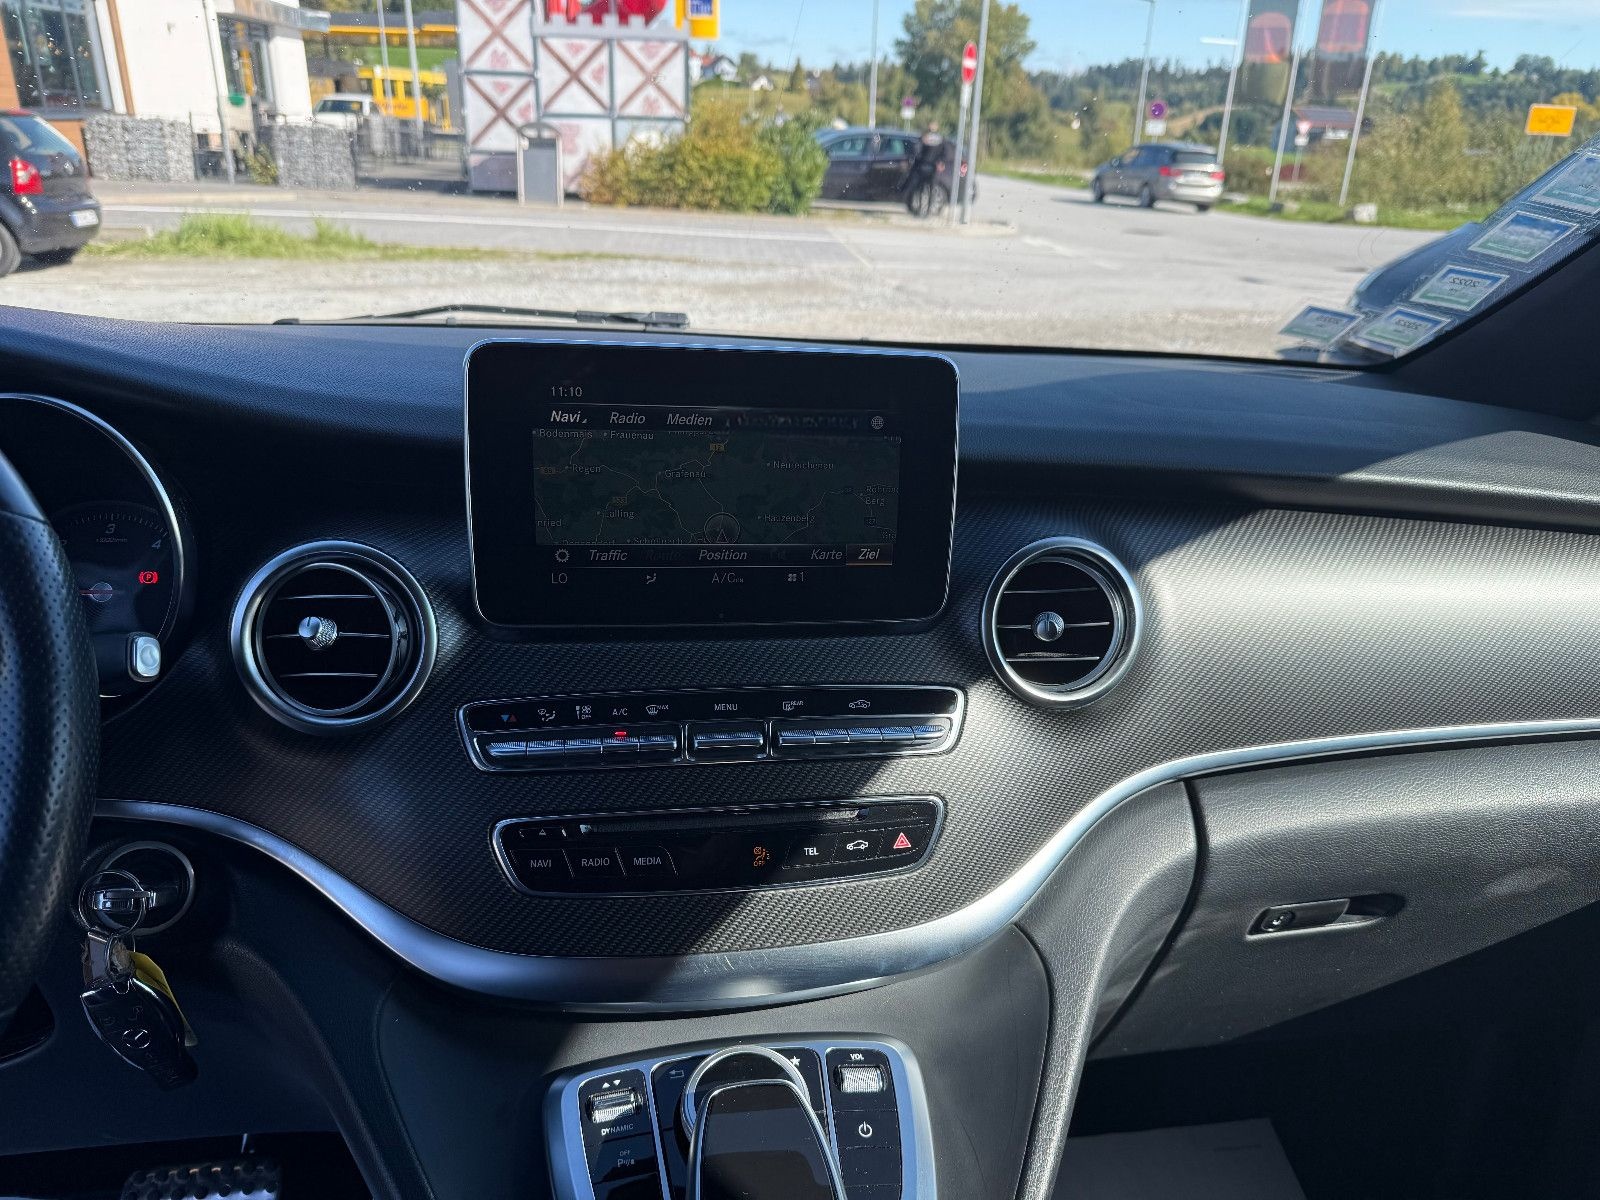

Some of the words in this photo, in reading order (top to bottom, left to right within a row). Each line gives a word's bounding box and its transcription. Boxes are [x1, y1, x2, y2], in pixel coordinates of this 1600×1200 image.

[551, 386, 583, 397] 11:10
[550, 410, 582, 423] Navi
[609, 412, 646, 425] Radio
[666, 413, 713, 426] Medien
[589, 549, 629, 561] Traffic
[698, 549, 748, 561] Position
[810, 549, 843, 560] Karte
[857, 549, 880, 560] Ziel
[551, 573, 568, 584] LO
[714, 703, 738, 711] MENU
[612, 708, 629, 717] A/C
[804, 847, 819, 856] TEL
[530, 859, 552, 868] NAVI
[581, 857, 610, 867] RADIO
[633, 856, 662, 866] MEDIA
[849, 1053, 865, 1061] VOL
[601, 1123, 635, 1136] DYNAMIC
